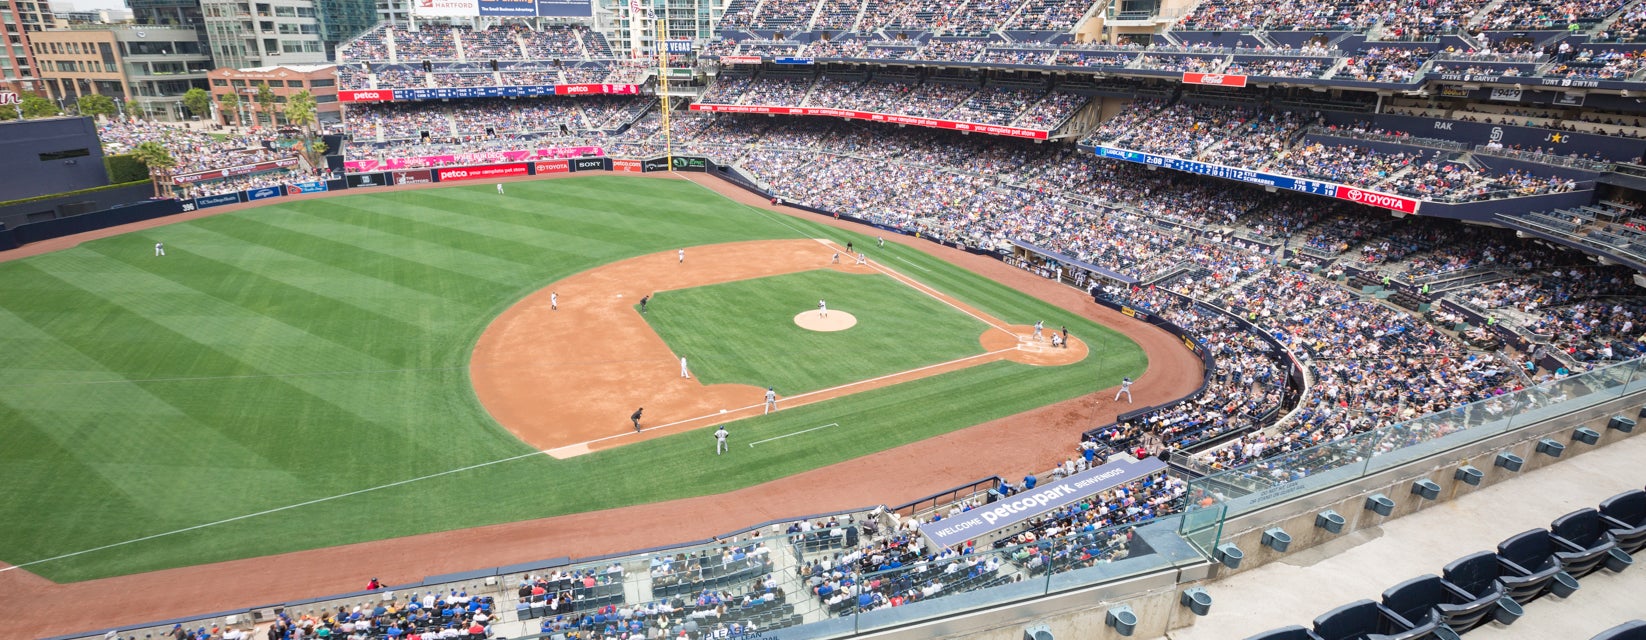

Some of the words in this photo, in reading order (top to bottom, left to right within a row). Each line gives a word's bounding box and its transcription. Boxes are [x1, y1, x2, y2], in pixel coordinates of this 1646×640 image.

[670, 42, 691, 52] VEGAS
[1561, 79, 1571, 87] 19
[354, 92, 380, 100] petco
[1434, 121, 1453, 130] RAK
[1146, 156, 1162, 165] 2:08
[440, 170, 468, 179] petco
[1232, 170, 1242, 179] 12
[1363, 192, 1404, 210] TOYOTA
[936, 516, 983, 538] WELCOME
[980, 482, 1078, 526] petcopark
[1074, 467, 1125, 490] BIENVENIDOS
[704, 626, 748, 640] PLEASE
